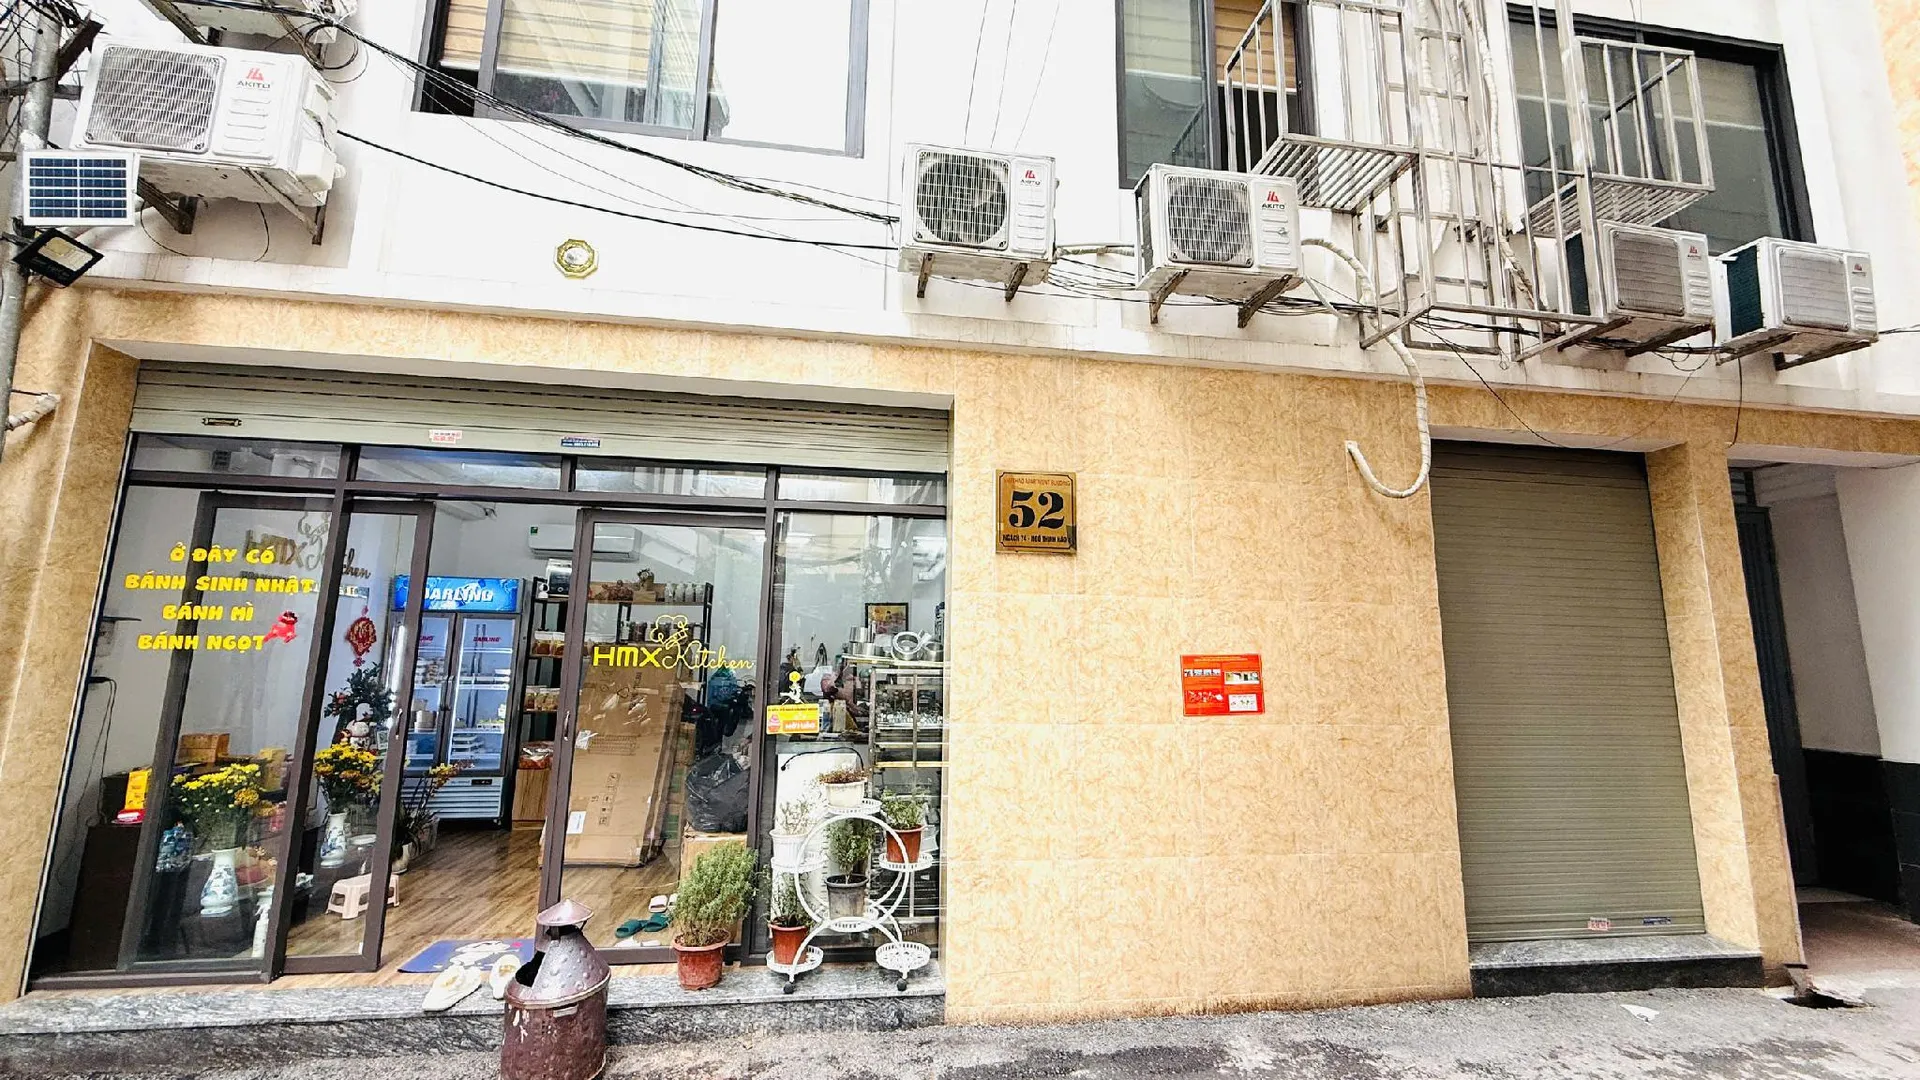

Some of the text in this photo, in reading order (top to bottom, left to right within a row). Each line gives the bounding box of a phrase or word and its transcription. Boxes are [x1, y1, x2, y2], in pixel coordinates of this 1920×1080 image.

[1009, 490, 1065, 529] 52
[170, 541, 275, 563] Ở ĐÂY CÓ
[125, 570, 186, 589] BÁNH
[195, 576, 248, 592] SINH
[255, 575, 312, 595] NHẬT
[162, 601, 254, 621] BÁNH MÌ
[137, 630, 264, 654] BÁNH NGỌT
[592, 639, 756, 670] HMX Kitchen
